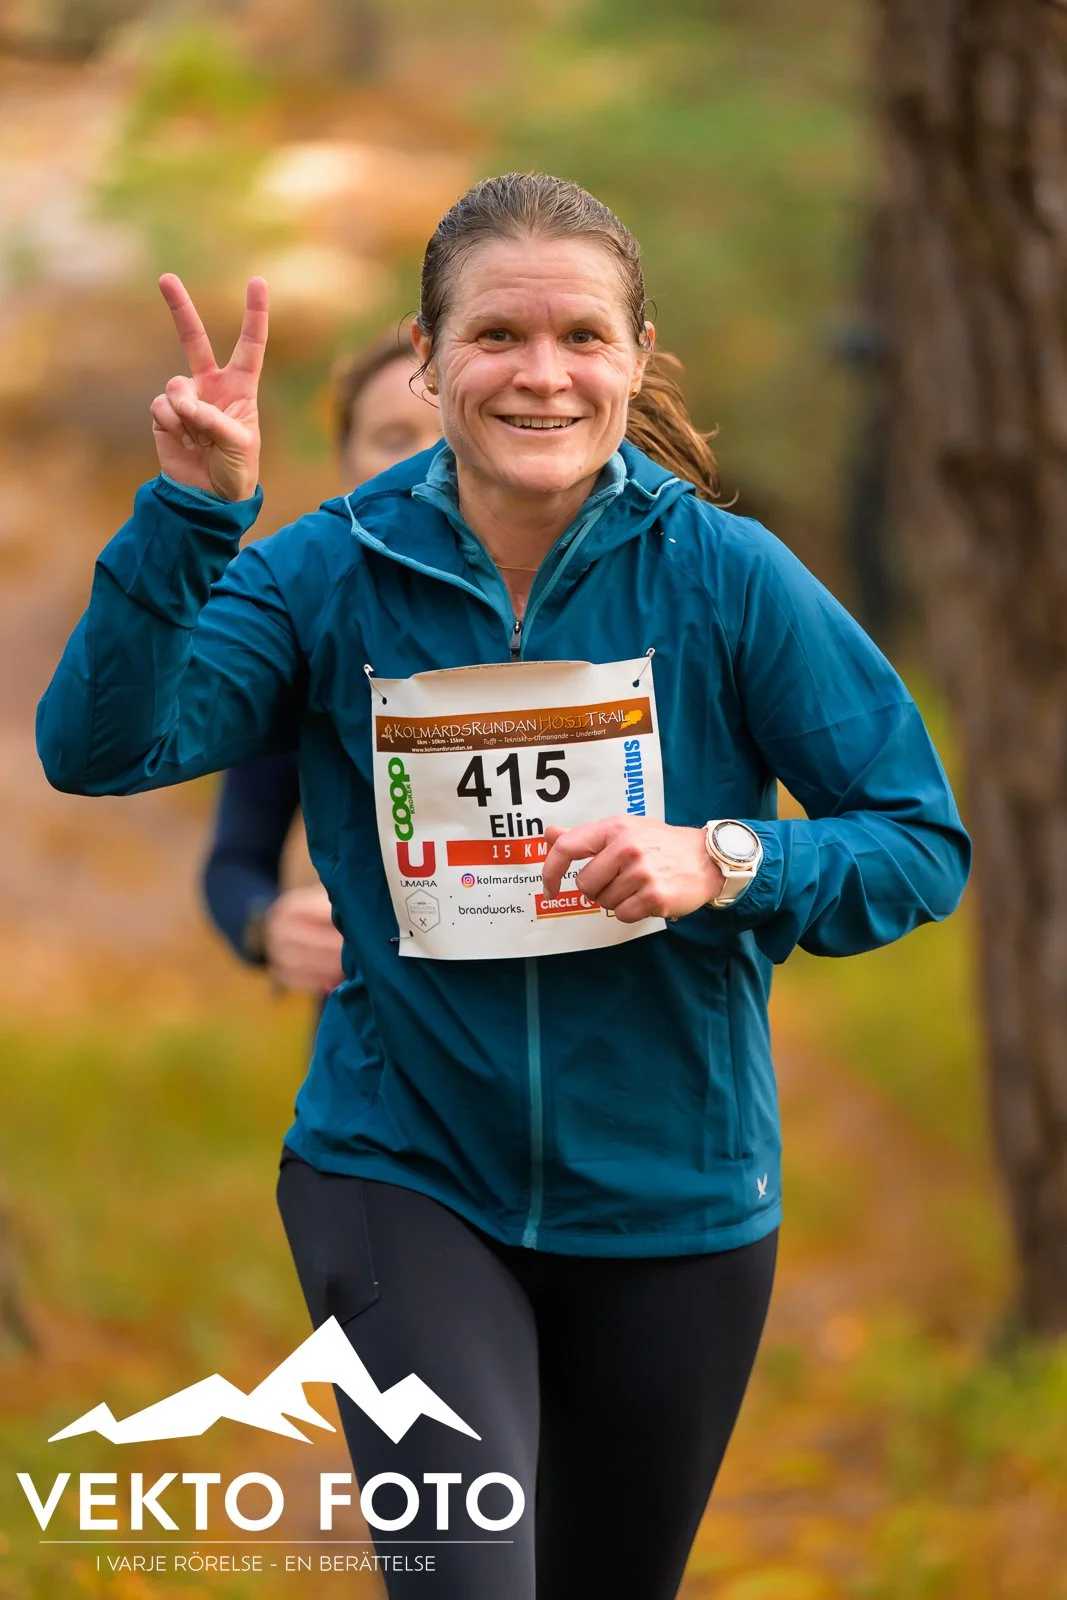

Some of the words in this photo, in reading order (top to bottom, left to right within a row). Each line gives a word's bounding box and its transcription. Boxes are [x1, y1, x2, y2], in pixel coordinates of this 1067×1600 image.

[575, 728, 607, 738] Underbart
[457, 750, 570, 807] 415
[387, 756, 414, 841] coop
[489, 812, 544, 838] Elin
[492, 844, 511, 859] 15
[524, 842, 548, 858] KM
[400, 880, 438, 888] UMARA
[458, 904, 525, 915] brandworks.
[540, 897, 578, 909] CIRCLE
